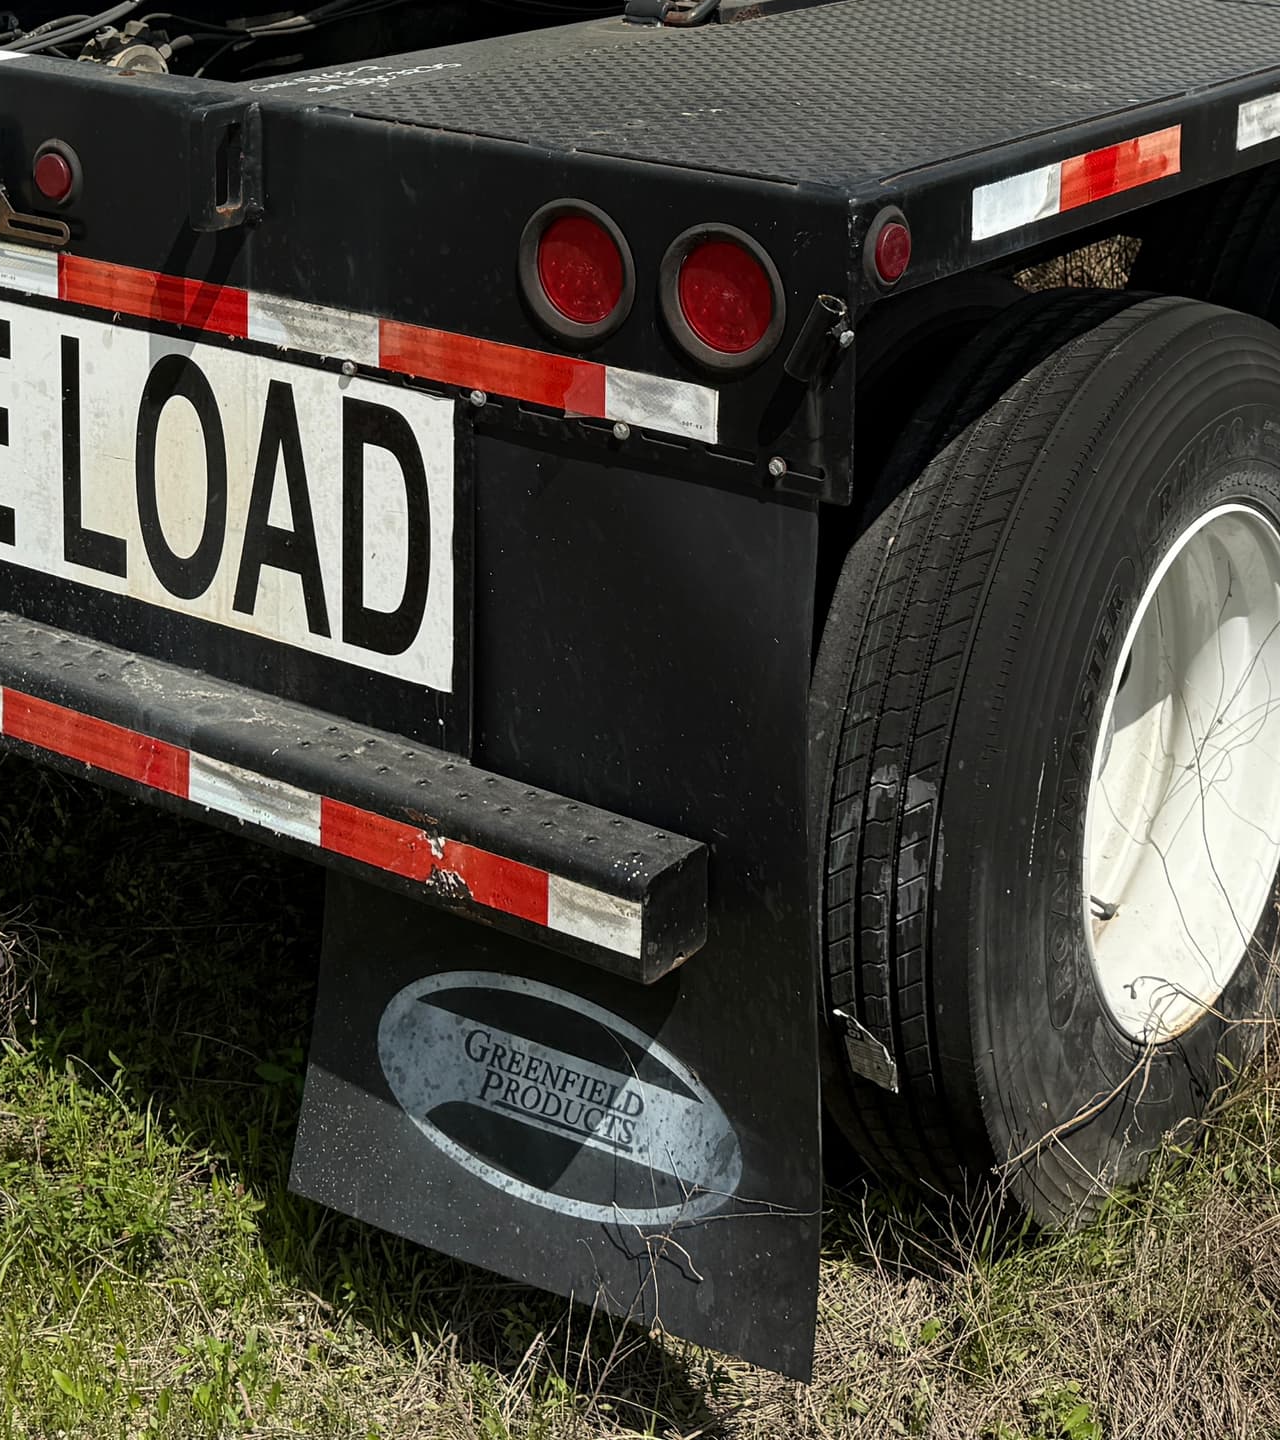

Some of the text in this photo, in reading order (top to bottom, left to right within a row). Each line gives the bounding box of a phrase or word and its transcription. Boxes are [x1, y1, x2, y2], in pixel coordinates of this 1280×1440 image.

[61, 334, 431, 656] LOAD
[1051, 582, 1125, 1001] ROADMASTER
[464, 1029, 645, 1118] GREENFIELD
[476, 1068, 638, 1145] PRODUCTS
